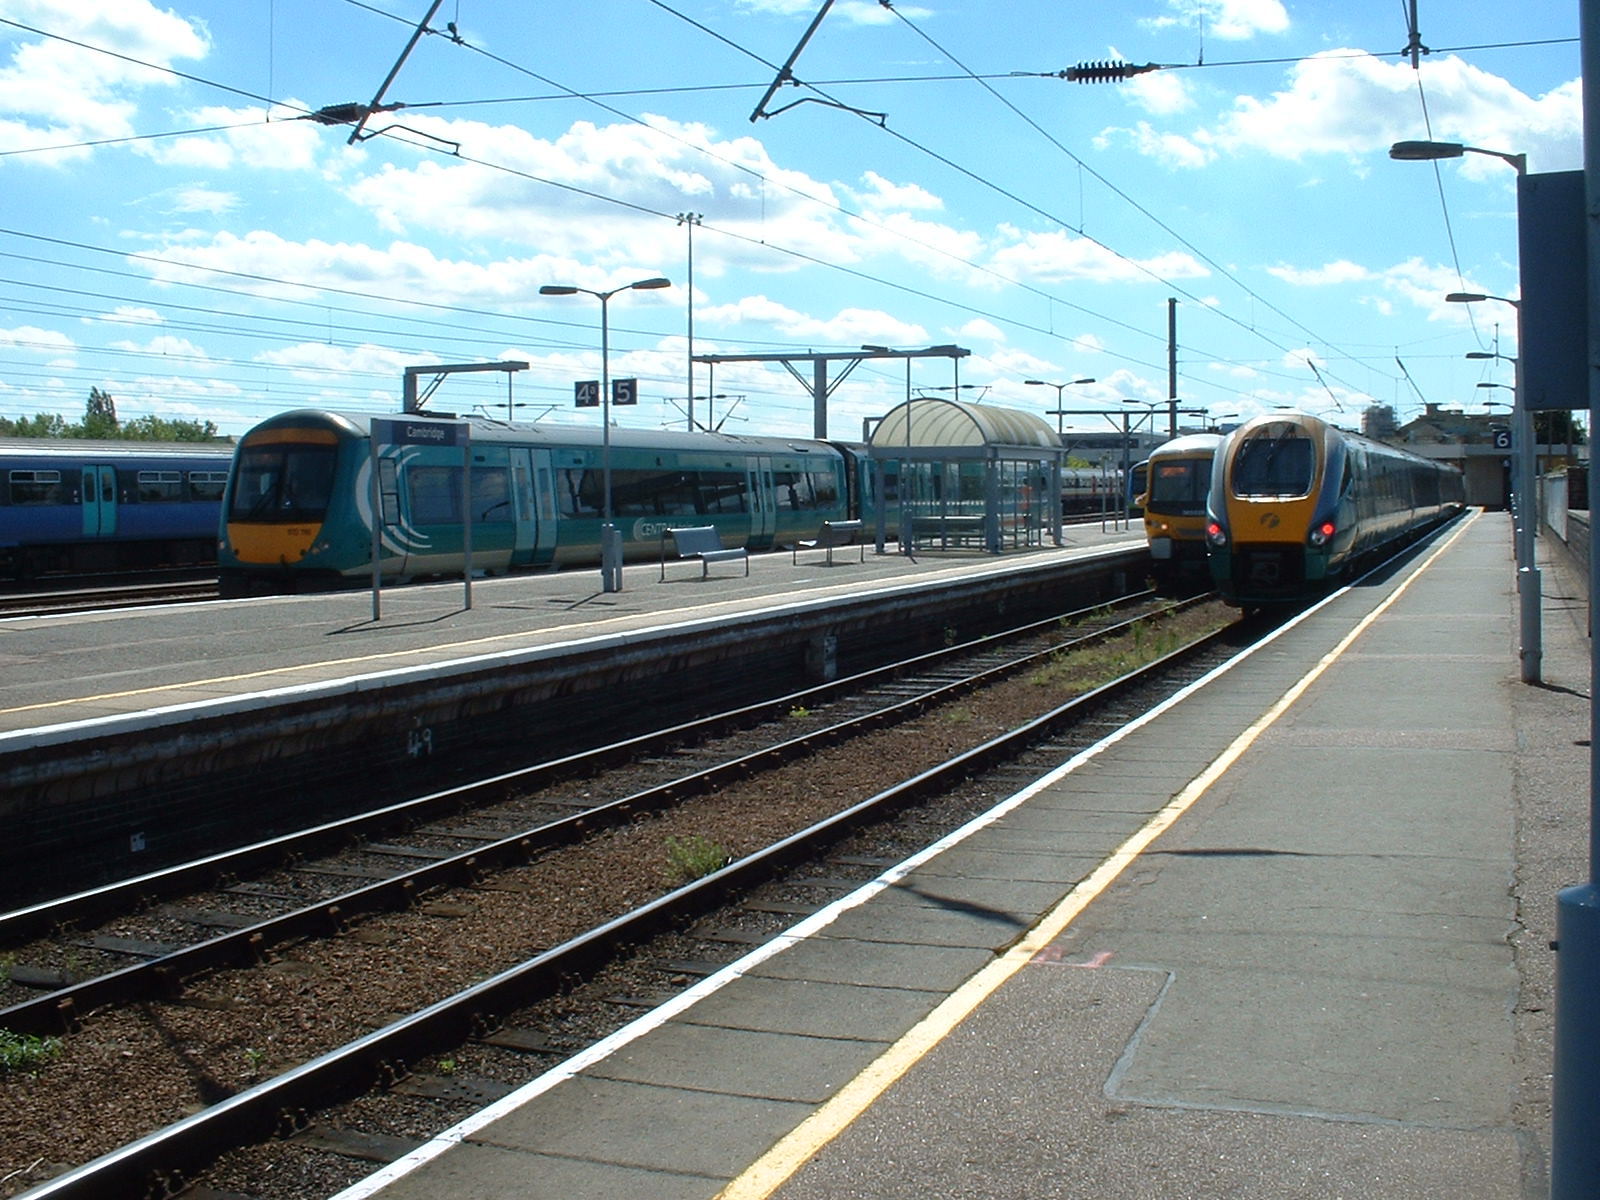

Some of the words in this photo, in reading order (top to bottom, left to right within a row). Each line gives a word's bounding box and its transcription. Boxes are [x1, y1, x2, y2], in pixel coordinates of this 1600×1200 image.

[617, 382, 630, 403] 5
[407, 426, 445, 441] Cambridge
[1497, 432, 1509, 447] 6
